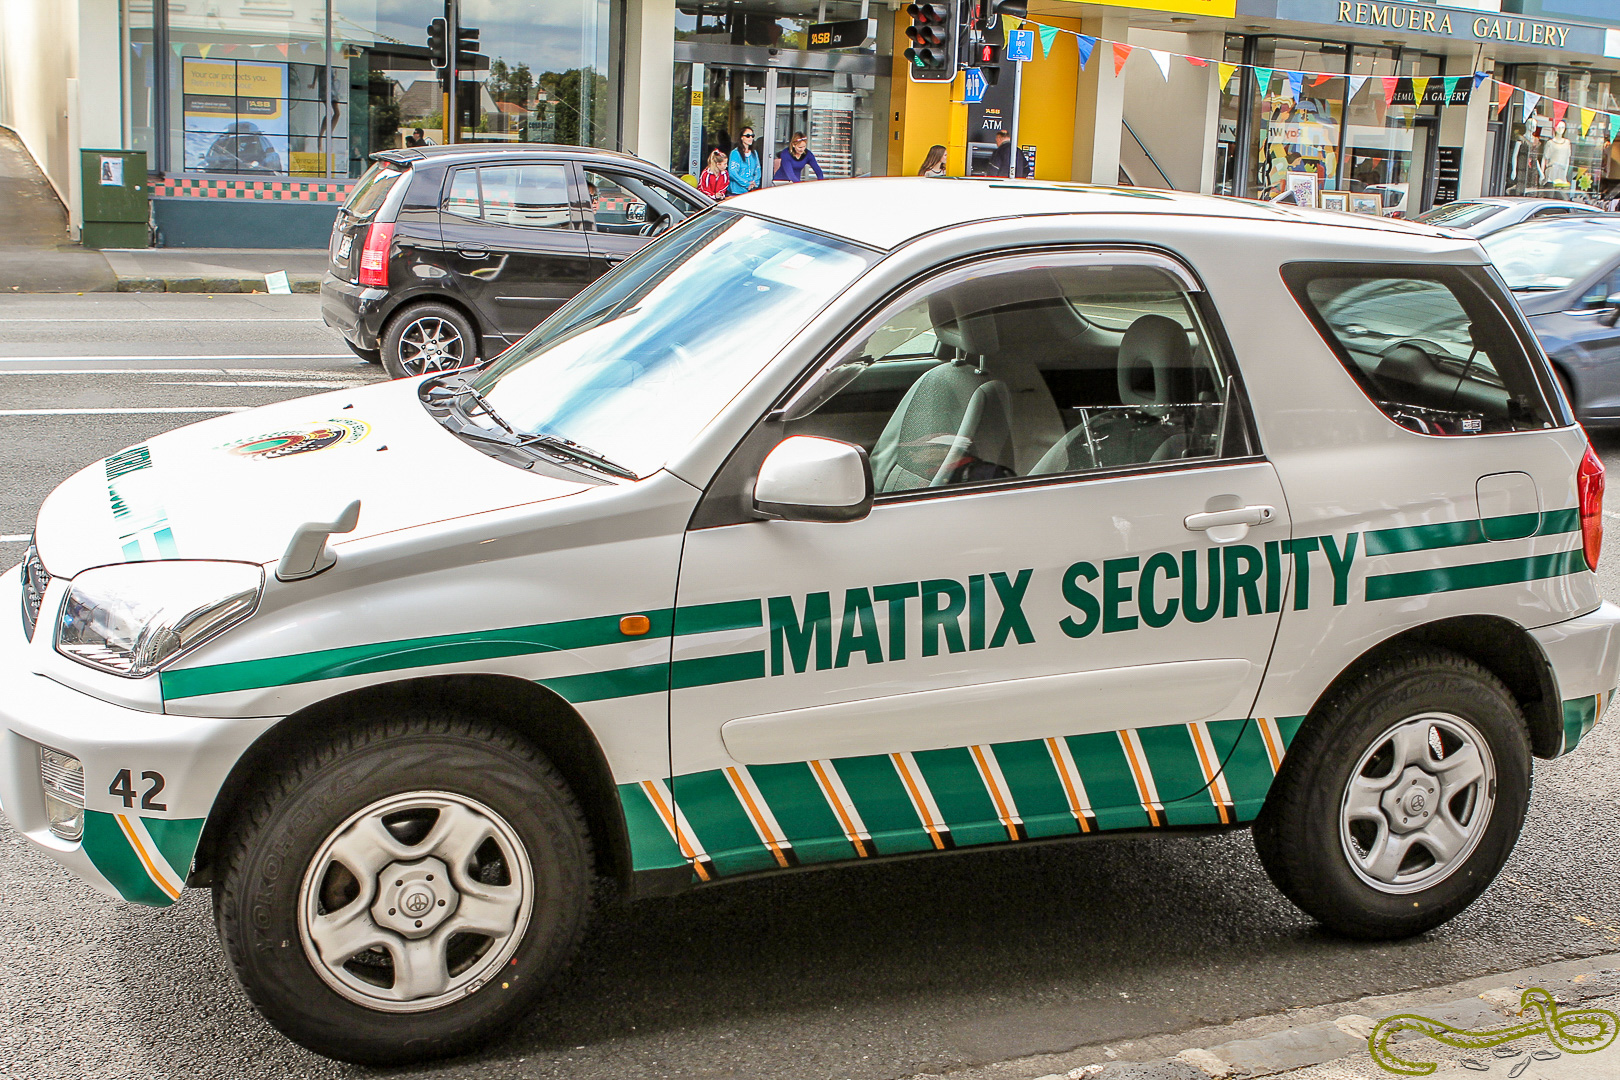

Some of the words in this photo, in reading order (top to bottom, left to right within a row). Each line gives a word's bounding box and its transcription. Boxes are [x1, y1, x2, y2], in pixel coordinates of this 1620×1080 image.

[1337, 1, 1453, 34] REMUERA
[1472, 17, 1571, 48] GALLERY
[811, 32, 831, 44] ASB
[191, 71, 208, 79] Your
[1393, 91, 1429, 101] REMUA
[1431, 91, 1468, 101] GALERY
[982, 119, 1002, 130] ATM
[768, 568, 1037, 677] MATRIX
[1058, 532, 1359, 640] SECURITY
[108, 768, 167, 811] 42
